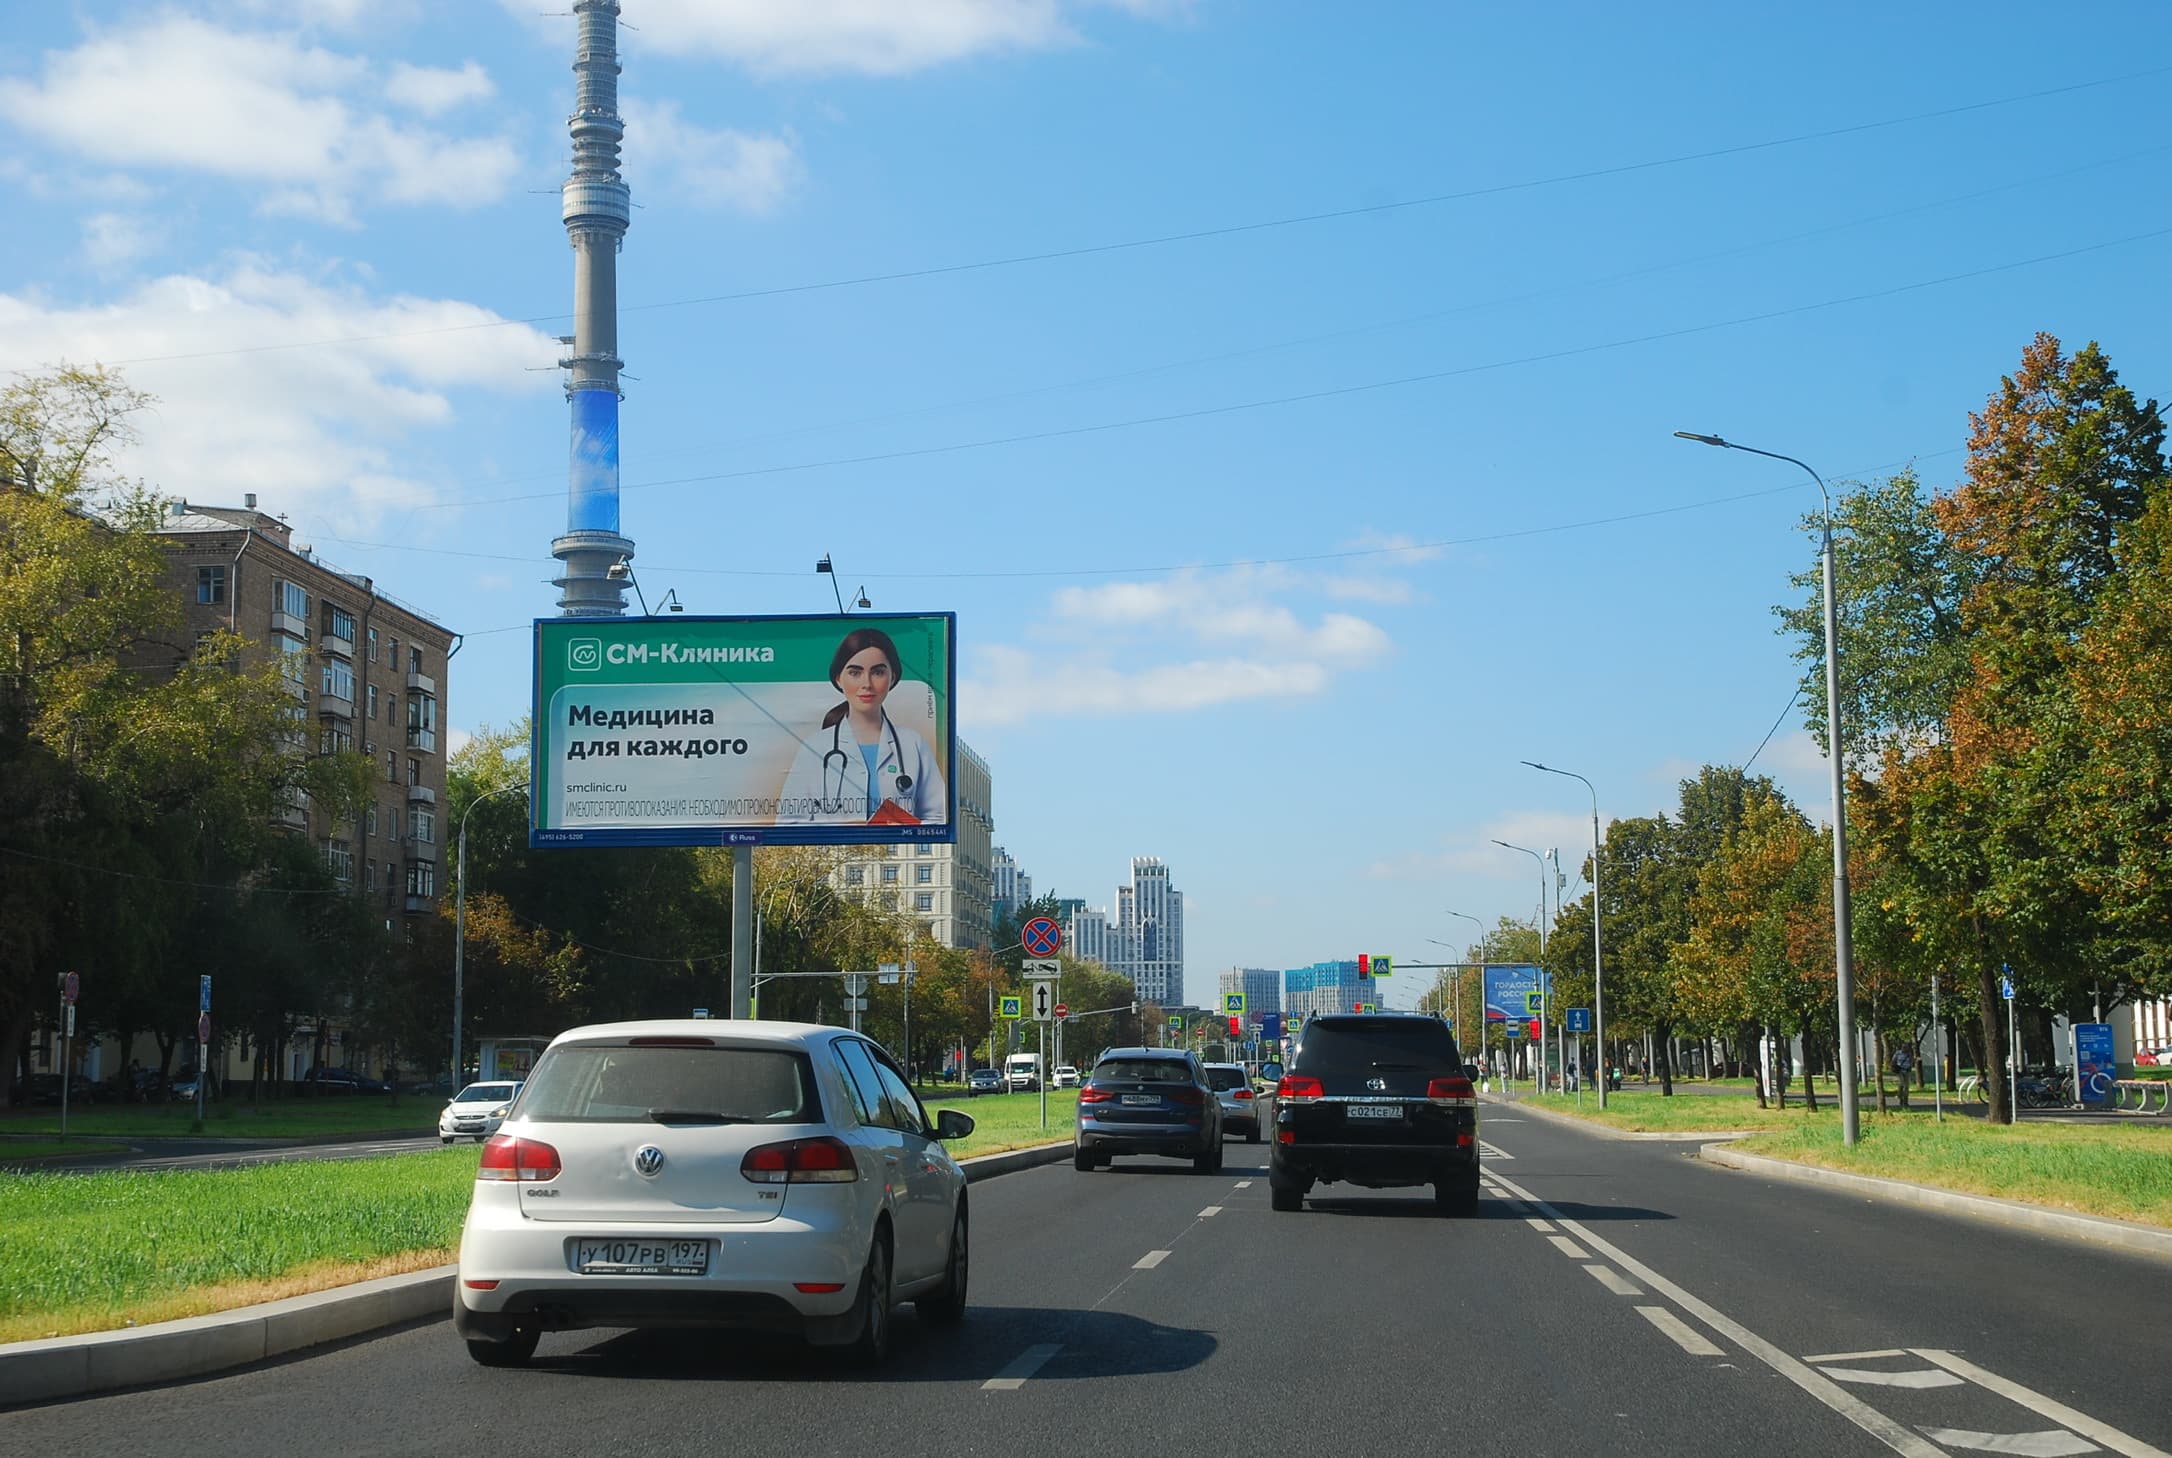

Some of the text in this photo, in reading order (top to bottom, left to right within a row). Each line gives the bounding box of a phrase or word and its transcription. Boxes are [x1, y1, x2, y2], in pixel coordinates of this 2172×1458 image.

[606, 643, 775, 665] СМ-Клиника
[568, 704, 715, 729] Медицина
[567, 737, 748, 760] для каждого
[566, 782, 627, 793] smclinic.ru
[565, 800, 604, 817] ИМЕЮТСЯ
[689, 798, 743, 817] НЕОБХОДИМО
[1494, 981, 1534, 990] ГОРДОСТ
[671, 1242, 701, 1259] 197
